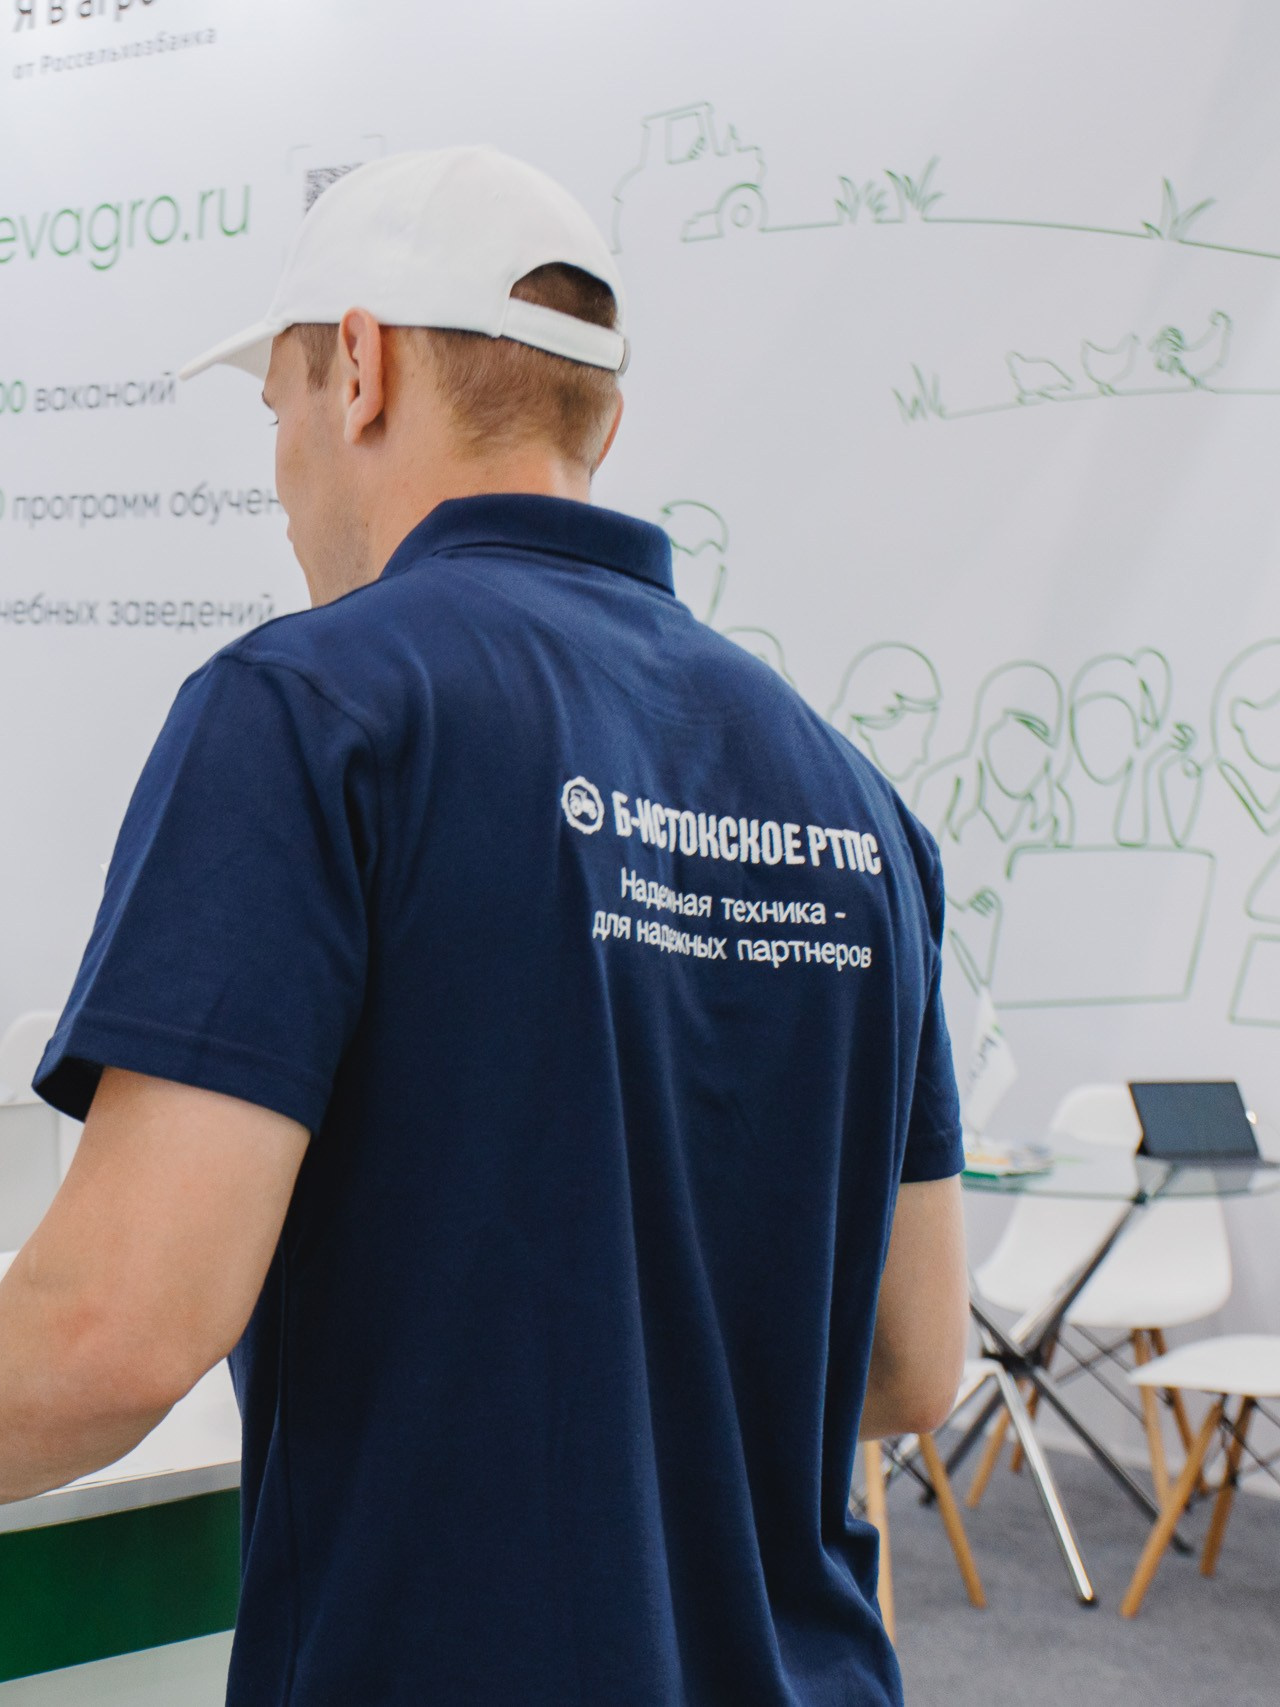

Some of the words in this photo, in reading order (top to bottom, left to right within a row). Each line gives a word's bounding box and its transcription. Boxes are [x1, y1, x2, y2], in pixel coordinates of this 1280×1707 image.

[13, 62, 35, 79] от
[40, 28, 217, 74] Россельхозбанка
[34, 372, 176, 413] вакансий
[13, 490, 160, 527] программ
[108, 593, 275, 631] заведений
[611, 790, 806, 866] Б-ИСТОКСКОЕ
[806, 824, 882, 875] РТПС
[621, 867, 712, 918] Наденая
[721, 898, 827, 924] техника
[592, 911, 631, 941] для
[737, 939, 872, 971] партнеров
